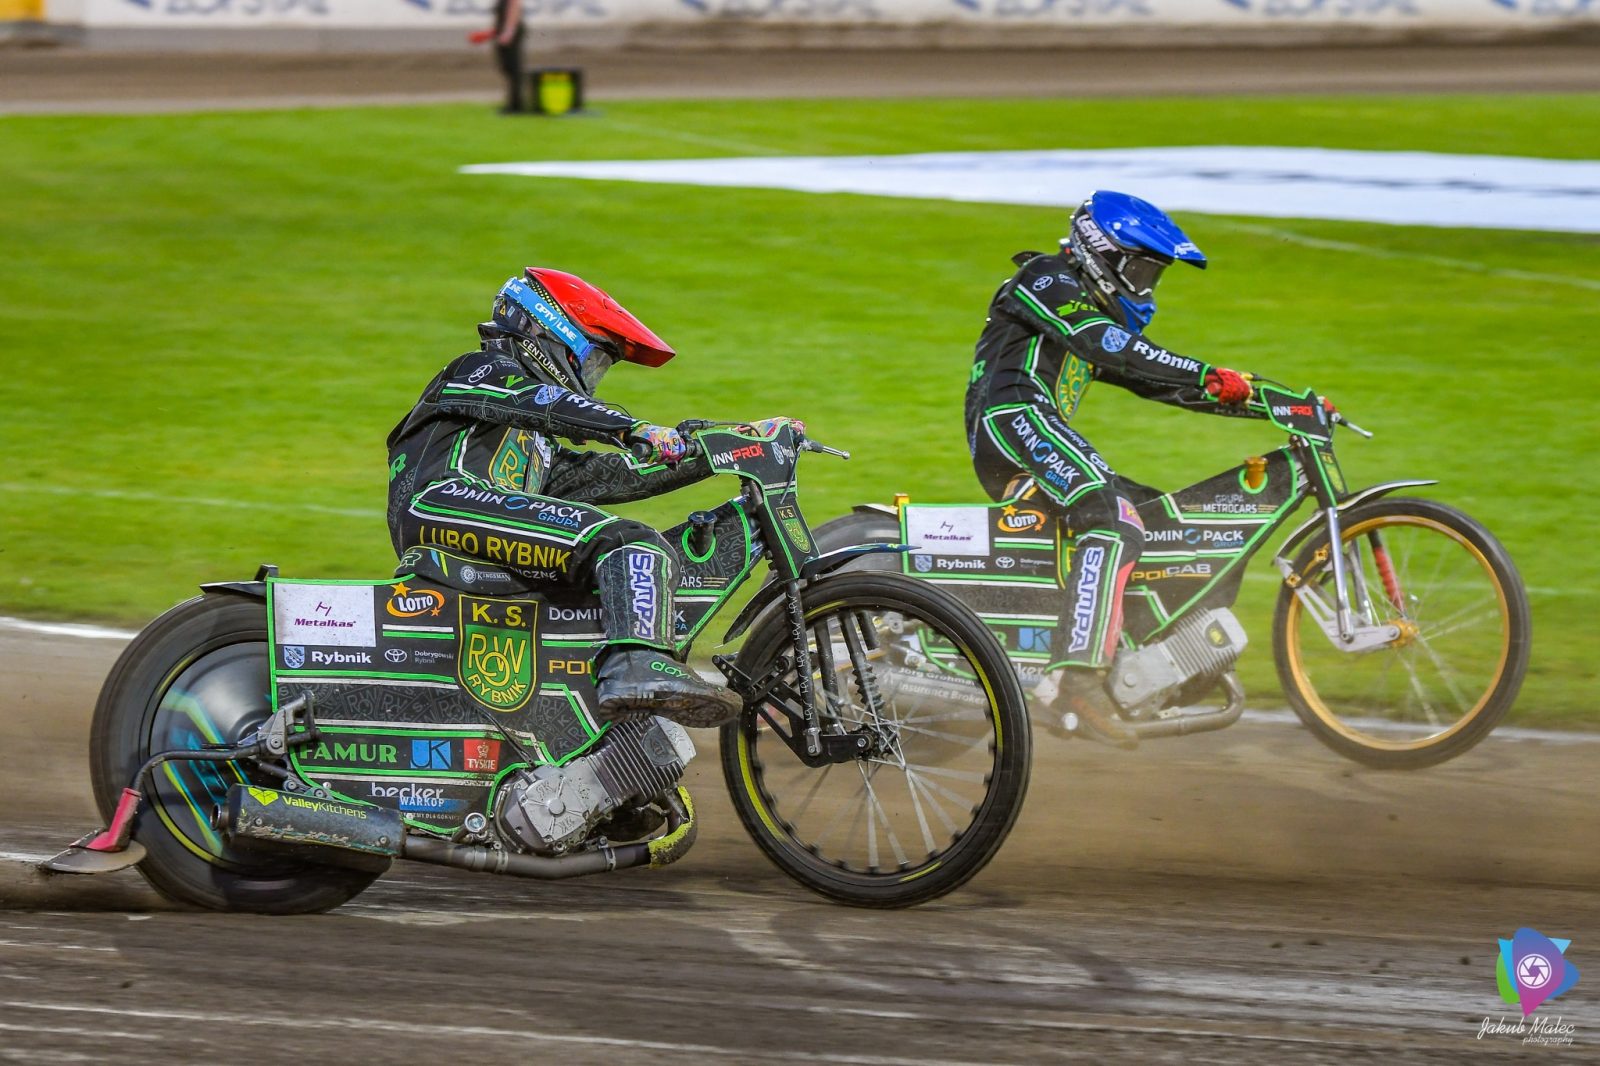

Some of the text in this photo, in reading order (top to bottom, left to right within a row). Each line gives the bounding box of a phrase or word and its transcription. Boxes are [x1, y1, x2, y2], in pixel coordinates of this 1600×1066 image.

[534, 302, 577, 342] OPTY LINE
[522, 339, 561, 376] CENTURY
[1133, 340, 1200, 373] Rybnik
[1044, 451, 1080, 484] PACK
[527, 500, 588, 523] PACK
[1203, 503, 1258, 514] METROCARS
[537, 511, 582, 529] GRUPA
[1007, 514, 1037, 529] LOTTO
[922, 533, 973, 543] Metalkas
[1202, 529, 1244, 542] PACK
[485, 535, 573, 574] RYBNIK
[936, 558, 986, 571] Rybnik
[1130, 563, 1212, 581] POLCAB
[398, 593, 434, 613] LOTTO
[1068, 547, 1104, 653] SAMPA
[294, 617, 353, 629] Metalkas
[311, 650, 372, 665] Rybnik
[467, 673, 528, 704] RYBNIK
[466, 758, 497, 770] TYSKIE
[370, 781, 444, 800] becker
[400, 795, 445, 808] WARKOP
